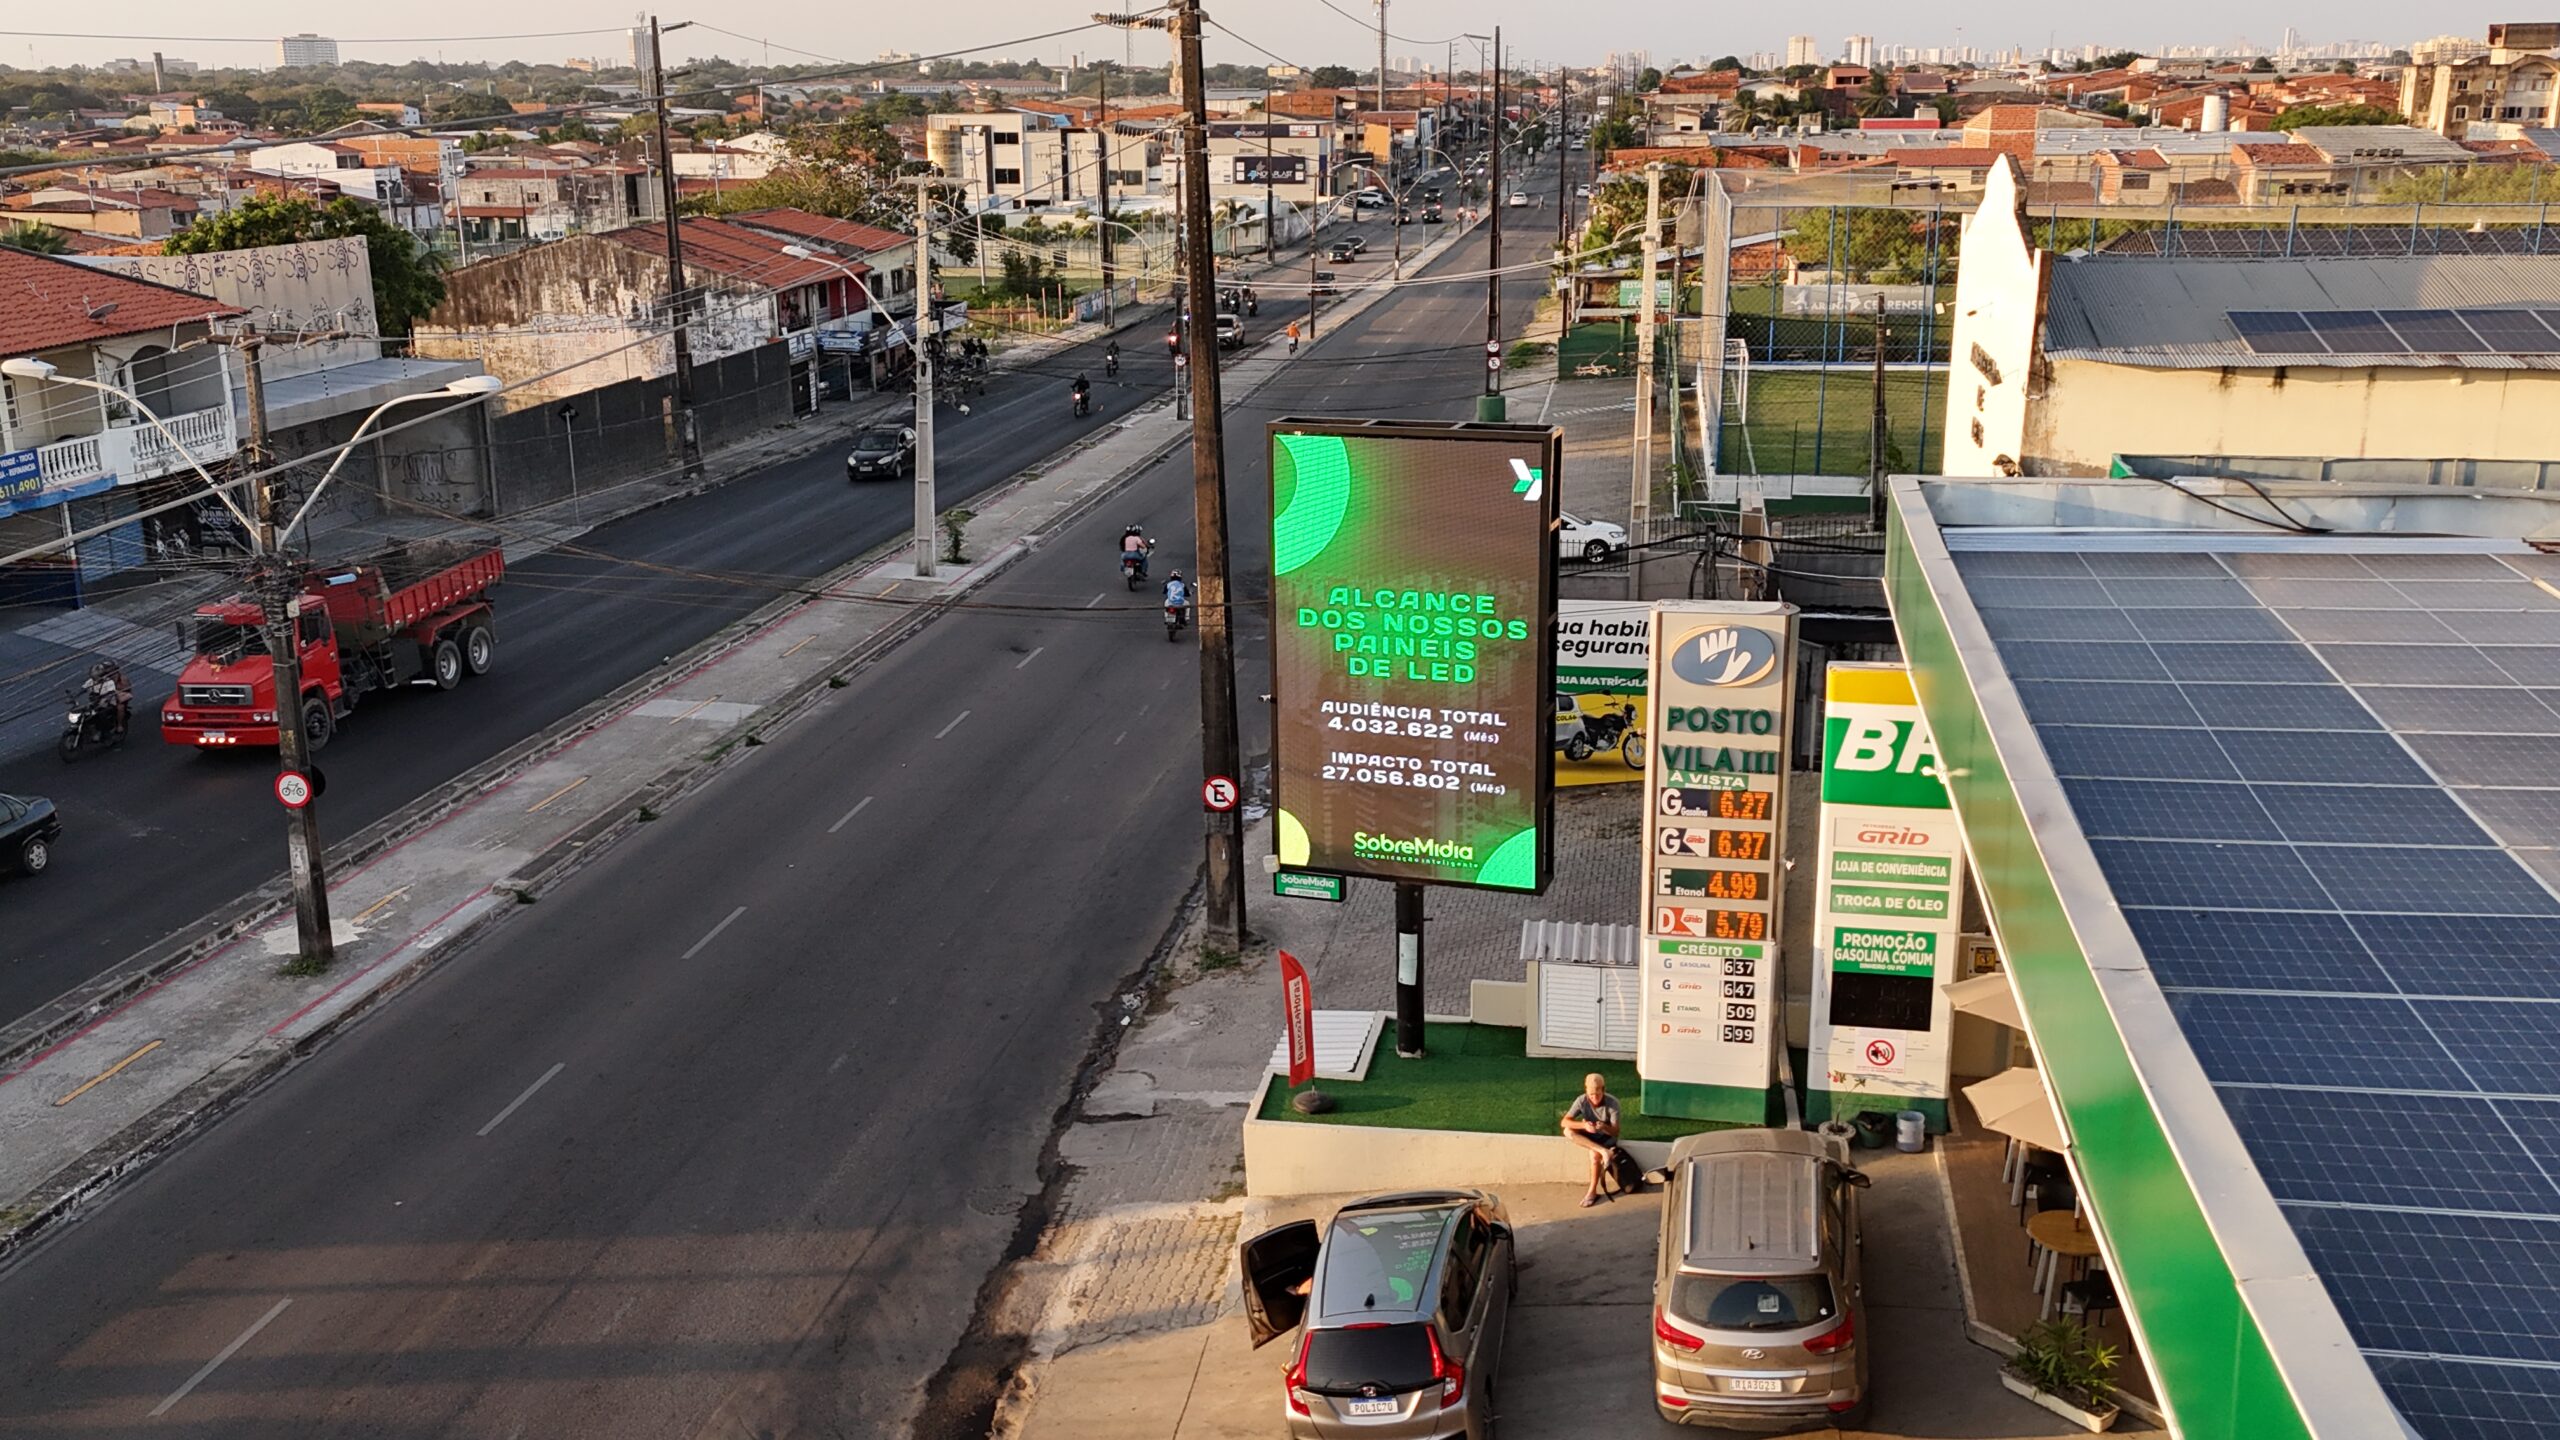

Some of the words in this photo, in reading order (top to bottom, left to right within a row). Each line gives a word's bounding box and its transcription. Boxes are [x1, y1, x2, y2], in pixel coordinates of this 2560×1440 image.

[1329, 587, 1496, 614] ALCANCE
[1299, 608, 1366, 630] DOS
[1383, 613, 1529, 640] NOSSOS
[1335, 632, 1476, 661] PAINÉIS
[18, 453, 34, 462] TROCA
[1885, 897, 1904, 909] DE
[1907, 896, 1944, 911] ÓLEO
[1349, 657, 1391, 678] DE
[1409, 661, 1475, 683] LED
[1580, 675, 1648, 687] MATRÍCULA
[1321, 701, 1431, 720] AUDIÊNCIA
[1440, 709, 1507, 726] TOTAL
[1667, 706, 1772, 735] POSTO
[1328, 716, 1454, 739] 4.032.622
[1463, 731, 1500, 744] (Mês)
[1331, 752, 1422, 770] IMPACTO
[1430, 759, 1496, 777] TOTAL
[1661, 744, 1734, 772] VILA
[1742, 750, 1776, 774] III
[1322, 765, 1460, 790] 27.056.802
[1470, 783, 1506, 795] (Mês)
[1689, 773, 1745, 787] VISTA
[1661, 788, 1682, 816] G
[1720, 791, 1768, 819] 6.27
[1660, 828, 1680, 855] G
[1718, 830, 1766, 860] 6.37
[1857, 827, 1930, 846] GRID
[1835, 860, 1859, 873] LOJA
[1861, 861, 1875, 874] DE
[1876, 862, 1947, 878] CONVENIÊNCIA
[1658, 868, 1672, 895] E
[1675, 886, 1706, 897] Etanol
[1709, 871, 1757, 899] 4.99
[1657, 907, 1675, 933] D
[1716, 911, 1763, 939] 5.79
[1678, 943, 1743, 956] CRÉDITO
[1842, 933, 1927, 951] PROMOÇÃO
[1664, 958, 1672, 969] G
[1724, 961, 1754, 974] 637
[1834, 948, 1889, 963] GASOLINA
[1892, 951, 1933, 966] COMUM
[1662, 979, 1671, 990] G
[1724, 983, 1754, 996] 647
[1294, 980, 1304, 1061] Banco24Horas
[1662, 1002, 1670, 1013] E
[1727, 1005, 1755, 1019] 509
[1661, 1024, 1670, 1034] D
[1724, 1027, 1753, 1040] 599
